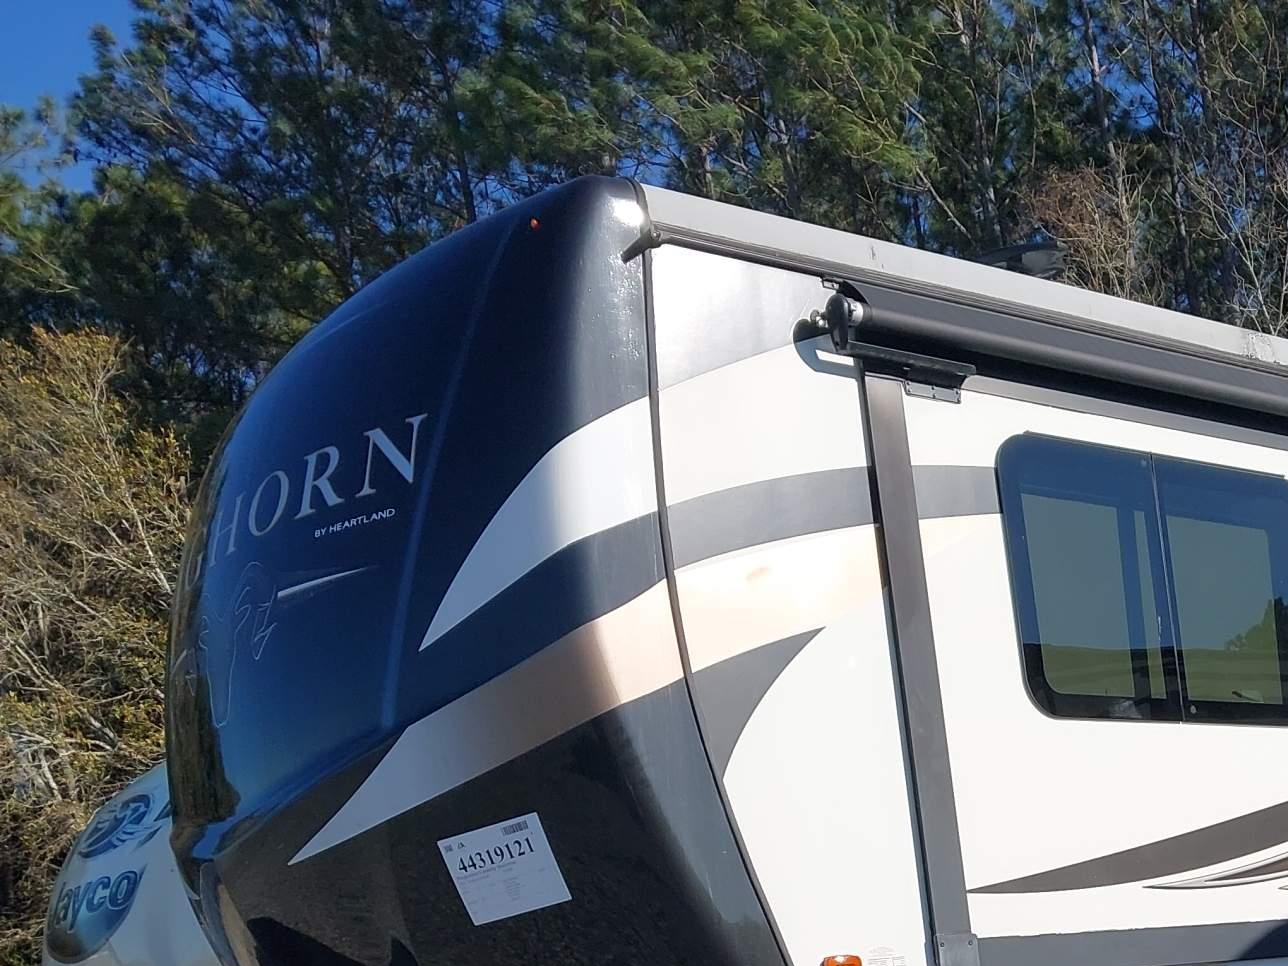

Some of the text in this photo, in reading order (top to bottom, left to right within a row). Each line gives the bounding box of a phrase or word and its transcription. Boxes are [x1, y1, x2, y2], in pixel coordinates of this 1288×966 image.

[314, 508, 396, 538] BY HEARTLAND
[458, 837, 535, 873] 44319121
